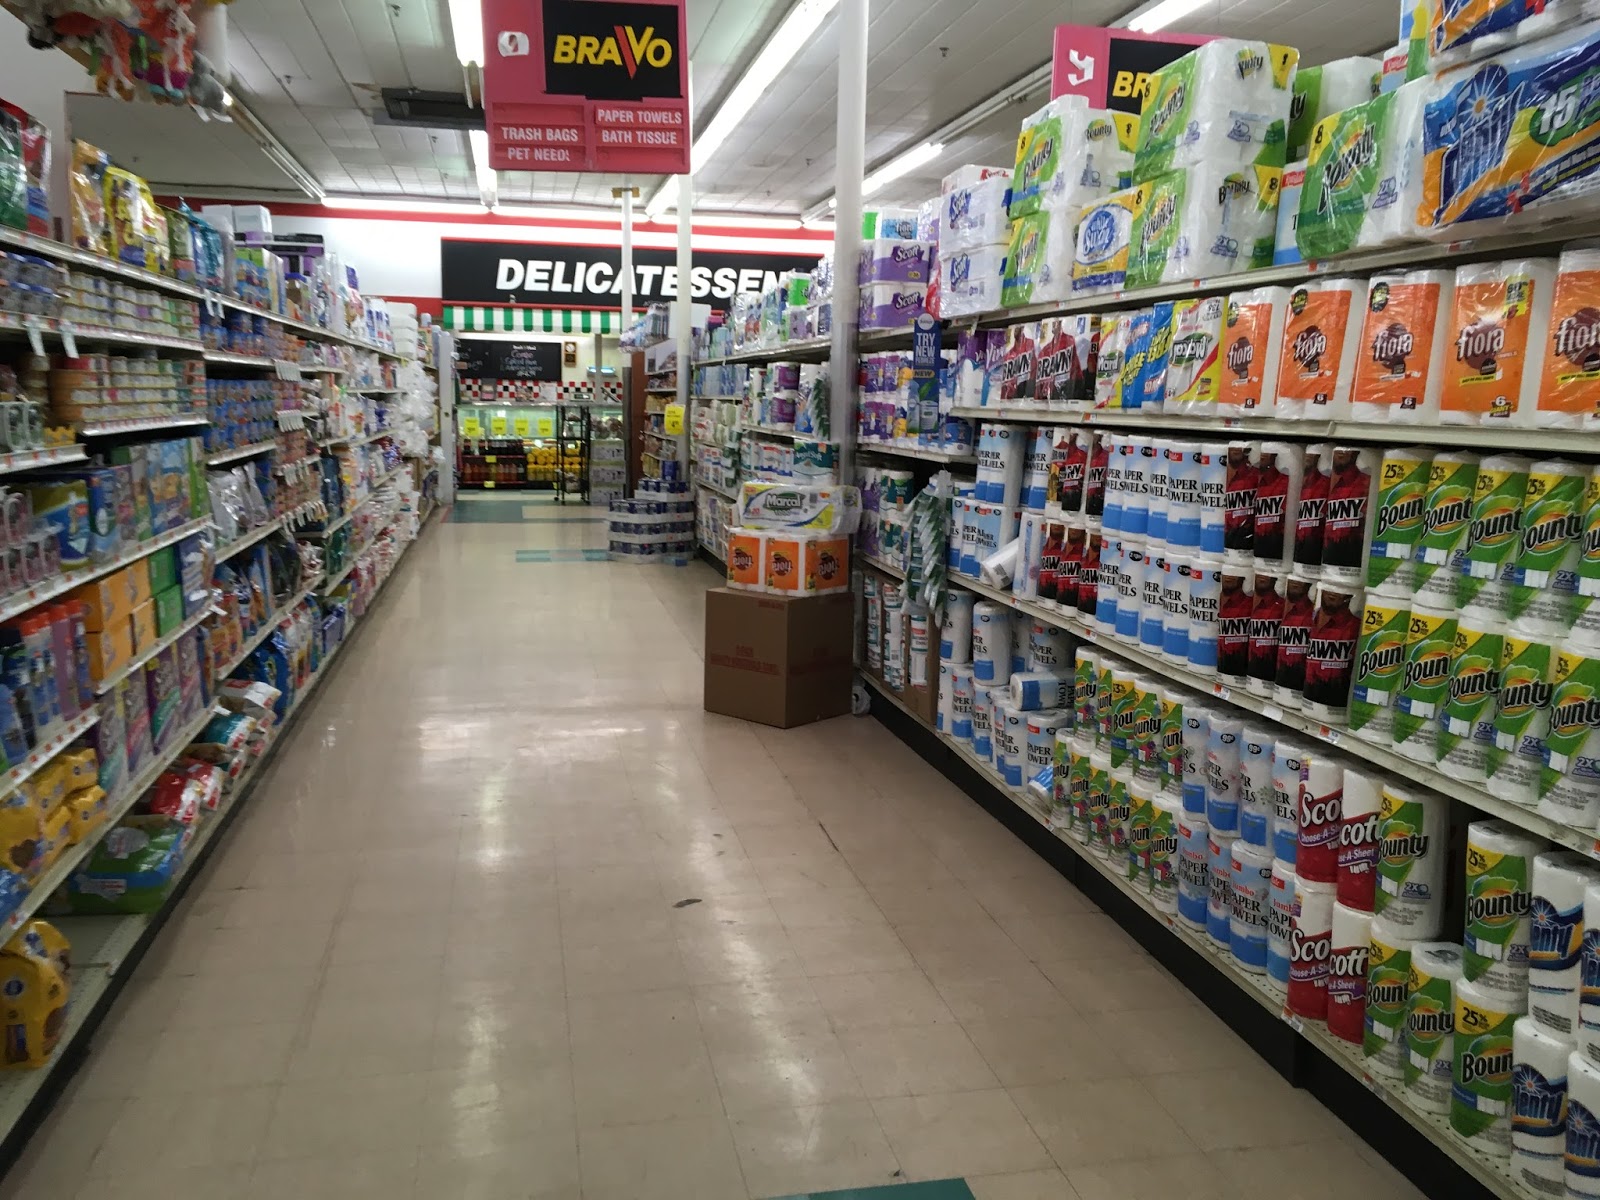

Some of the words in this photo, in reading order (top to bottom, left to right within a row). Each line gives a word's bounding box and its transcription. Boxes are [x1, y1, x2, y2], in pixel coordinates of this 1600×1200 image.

[553, 25, 673, 79] BRAVO
[1143, 81, 1151, 99] 8
[598, 109, 634, 123] PAPER
[637, 111, 682, 124] TOWELS
[1539, 85, 1578, 135] 15
[502, 127, 542, 141] TRASH
[546, 128, 579, 142] BAGS
[602, 130, 633, 143] BATH
[636, 131, 677, 144] TISSUE
[1314, 124, 1324, 144] 8
[1020, 137, 1027, 150] 8
[508, 148, 530, 160] PET
[1269, 177, 1279, 190] 8
[1136, 189, 1143, 205] 8
[896, 244, 920, 262] Scott
[896, 291, 920, 309] Scott
[916, 333, 936, 346] TRY
[1294, 331, 1327, 360] fiora
[1373, 330, 1414, 361] fiora
[1456, 326, 1505, 361] fiora
[915, 346, 936, 358] NEW
[1228, 341, 1254, 369] fiora
[1246, 398, 1253, 406] 6
[1404, 397, 1413, 406] 6
[1495, 396, 1506, 406] 6
[1169, 477, 1197, 490] PAPER
[766, 493, 801, 508] Marcal
[1326, 497, 1366, 521] WNY
[1307, 639, 1356, 661] AWNY
[1403, 654, 1452, 692] Boun
[1027, 741, 1051, 756] PAPER
[1577, 757, 1593, 768] 2X
[1178, 868, 1209, 887] TOWEL
[1405, 882, 1418, 891] 2X
[1467, 889, 1533, 928] Bounty
